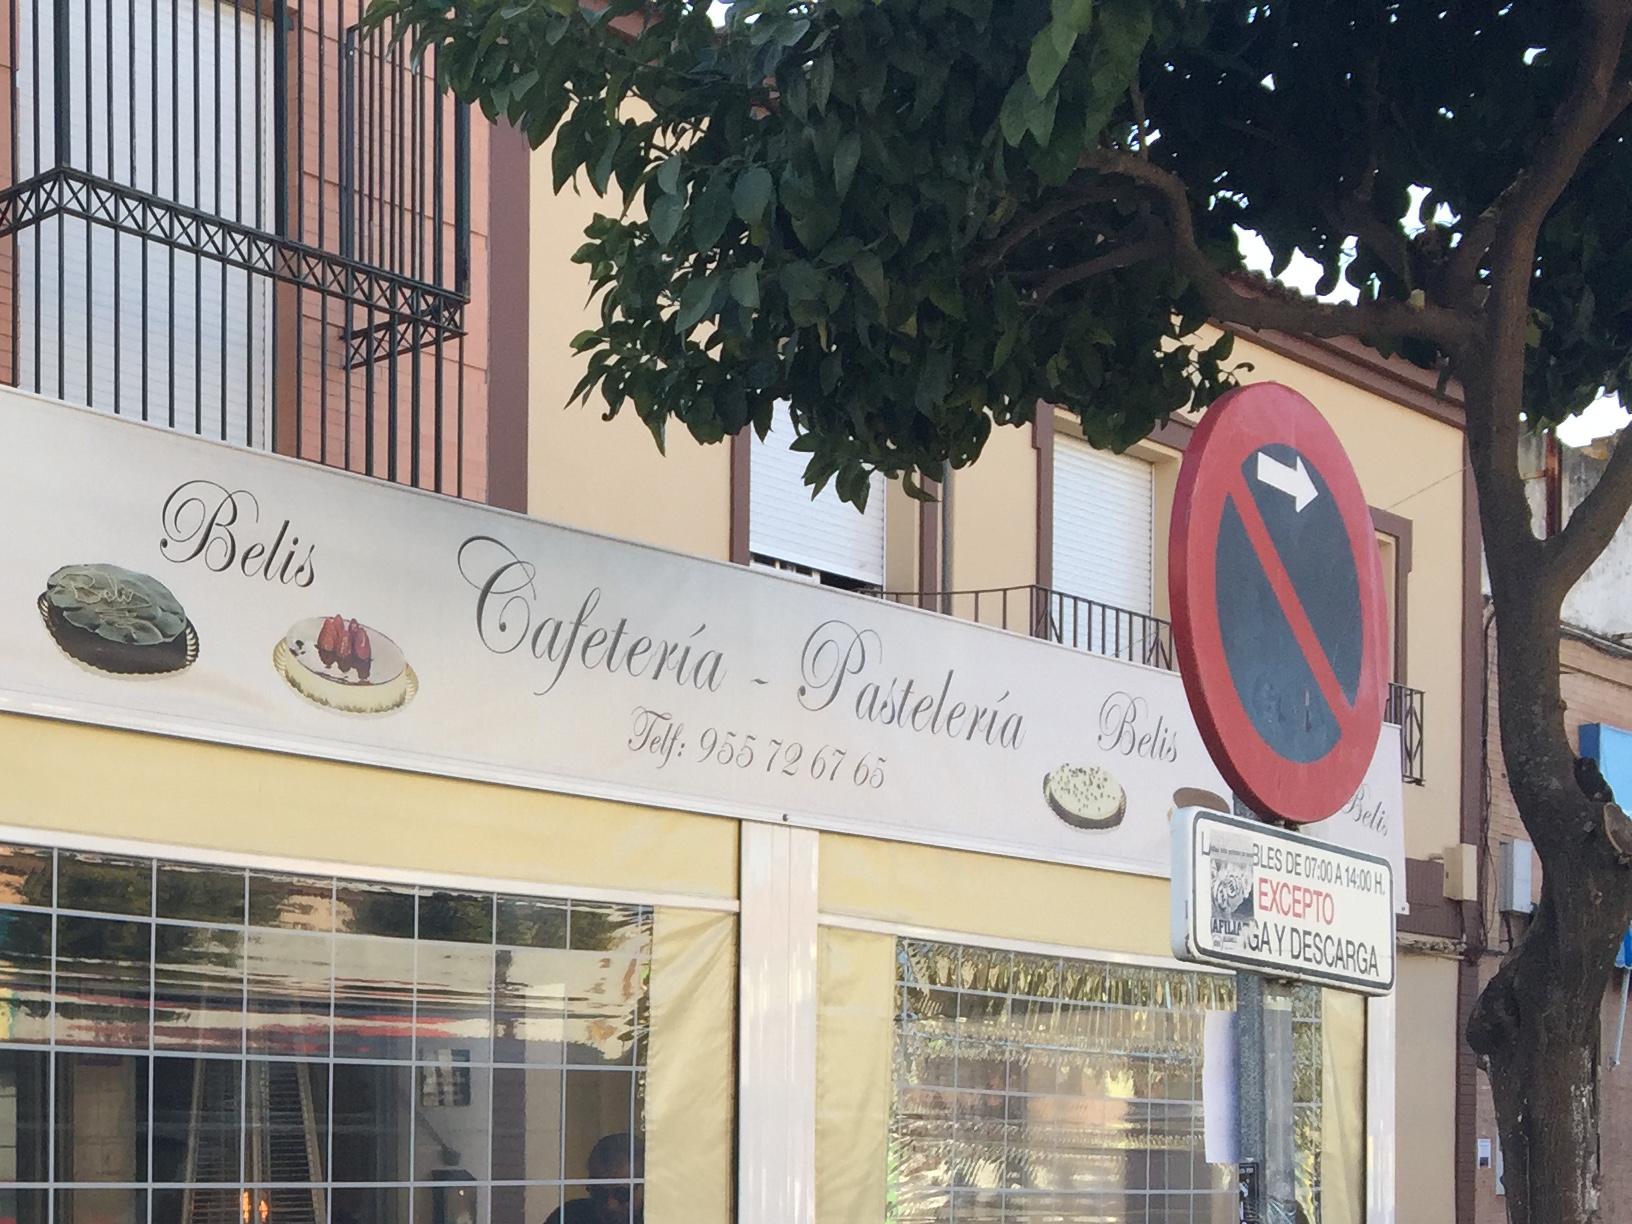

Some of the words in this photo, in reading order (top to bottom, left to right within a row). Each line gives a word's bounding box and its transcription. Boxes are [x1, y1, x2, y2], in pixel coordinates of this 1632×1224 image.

[159, 479, 318, 588] Belis
[457, 535, 727, 696] Cafetería
[797, 619, 1026, 751] Pastelería
[627, 705, 685, 769] Telf:
[696, 727, 757, 769] 955
[766, 738, 804, 777] 72
[810, 743, 848, 782] 67
[853, 751, 887, 789] 65
[1097, 690, 1179, 764] Belis
[1258, 877, 1335, 925] EXCEPTO
[1285, 850, 1302, 876] DE
[1304, 855, 1333, 884] 07:00
[1334, 863, 1343, 886] A
[1344, 865, 1372, 893] 14:00
[1274, 922, 1286, 957] Y
[1290, 927, 1380, 977] DESCARGA
